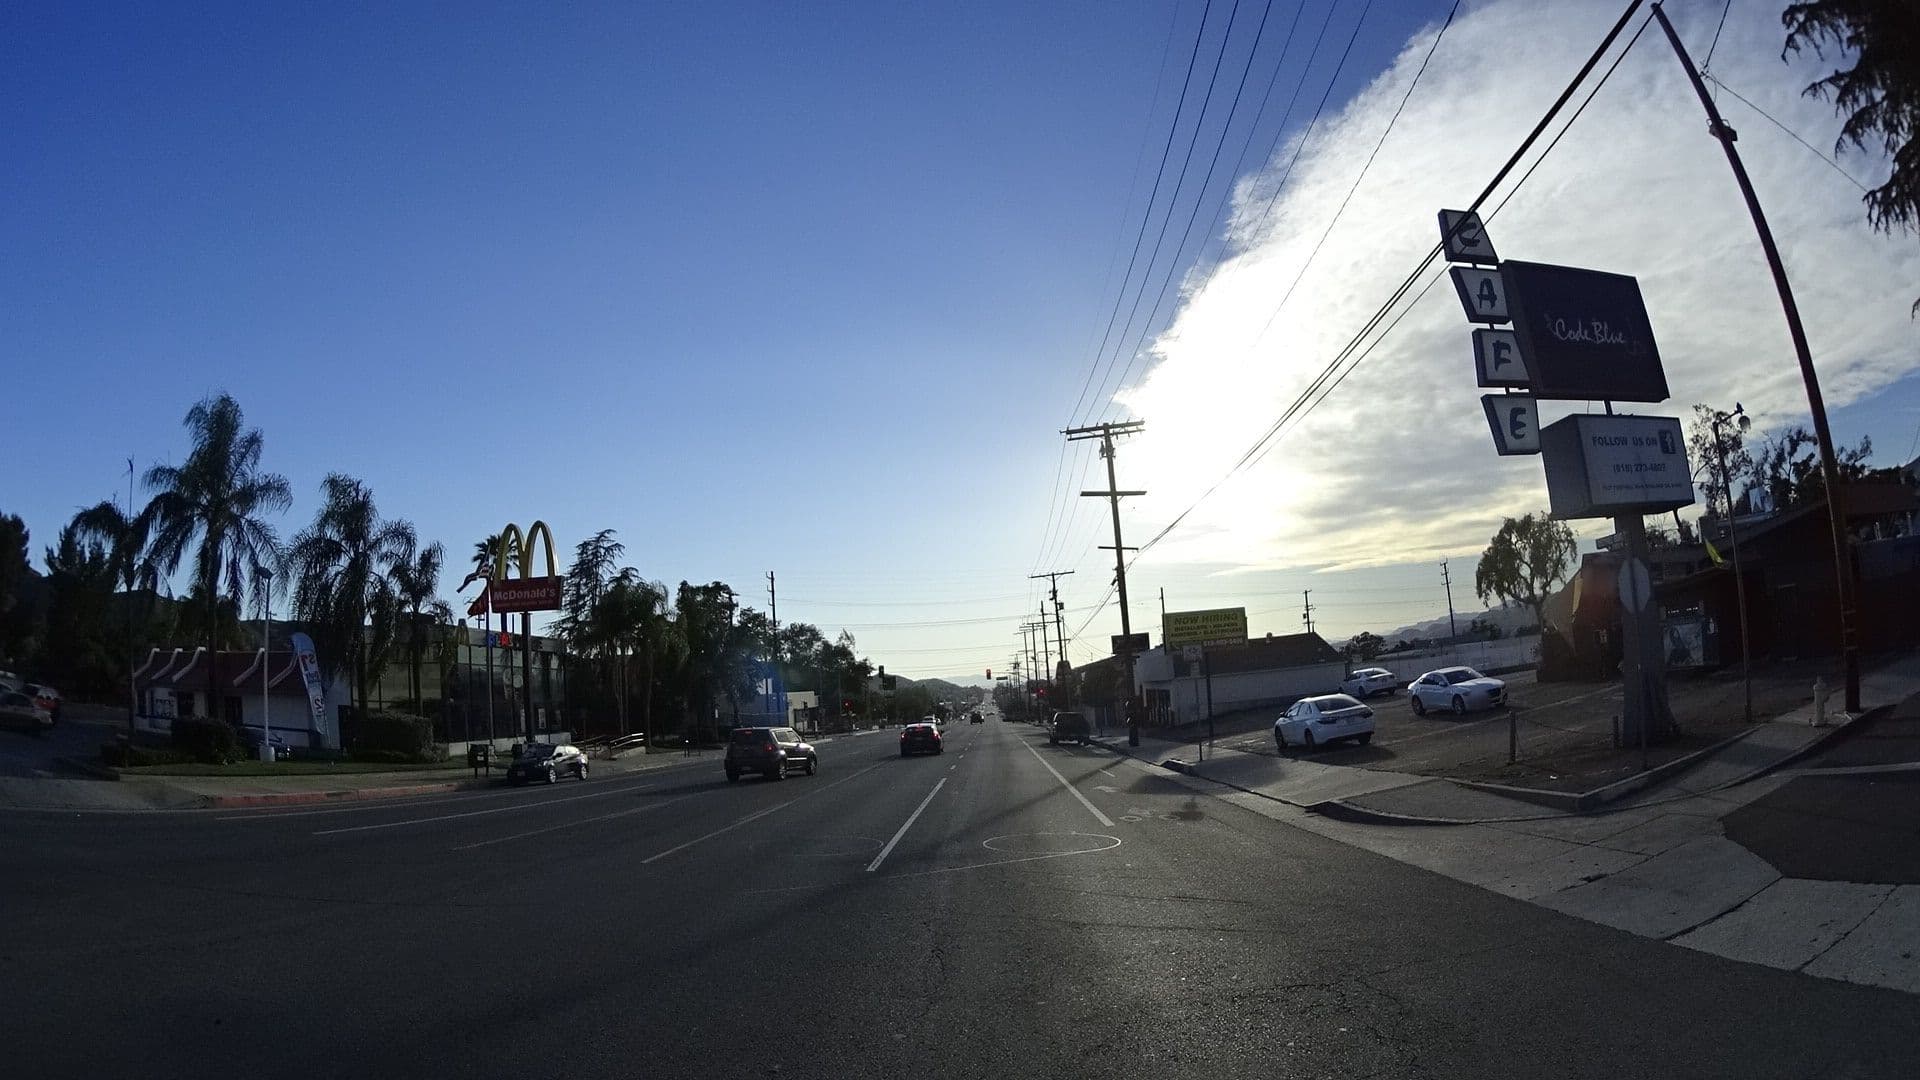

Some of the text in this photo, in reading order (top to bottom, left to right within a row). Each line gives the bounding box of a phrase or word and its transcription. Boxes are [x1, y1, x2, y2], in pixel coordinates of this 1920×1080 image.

[1553, 318, 1625, 344] Code Blue
[1592, 435, 1628, 447] FOLLOW
[1632, 435, 1643, 447] US
[1645, 436, 1658, 446] ON
[493, 587, 556, 601] McDonald's
[1174, 613, 1238, 625] NOW HIRING
